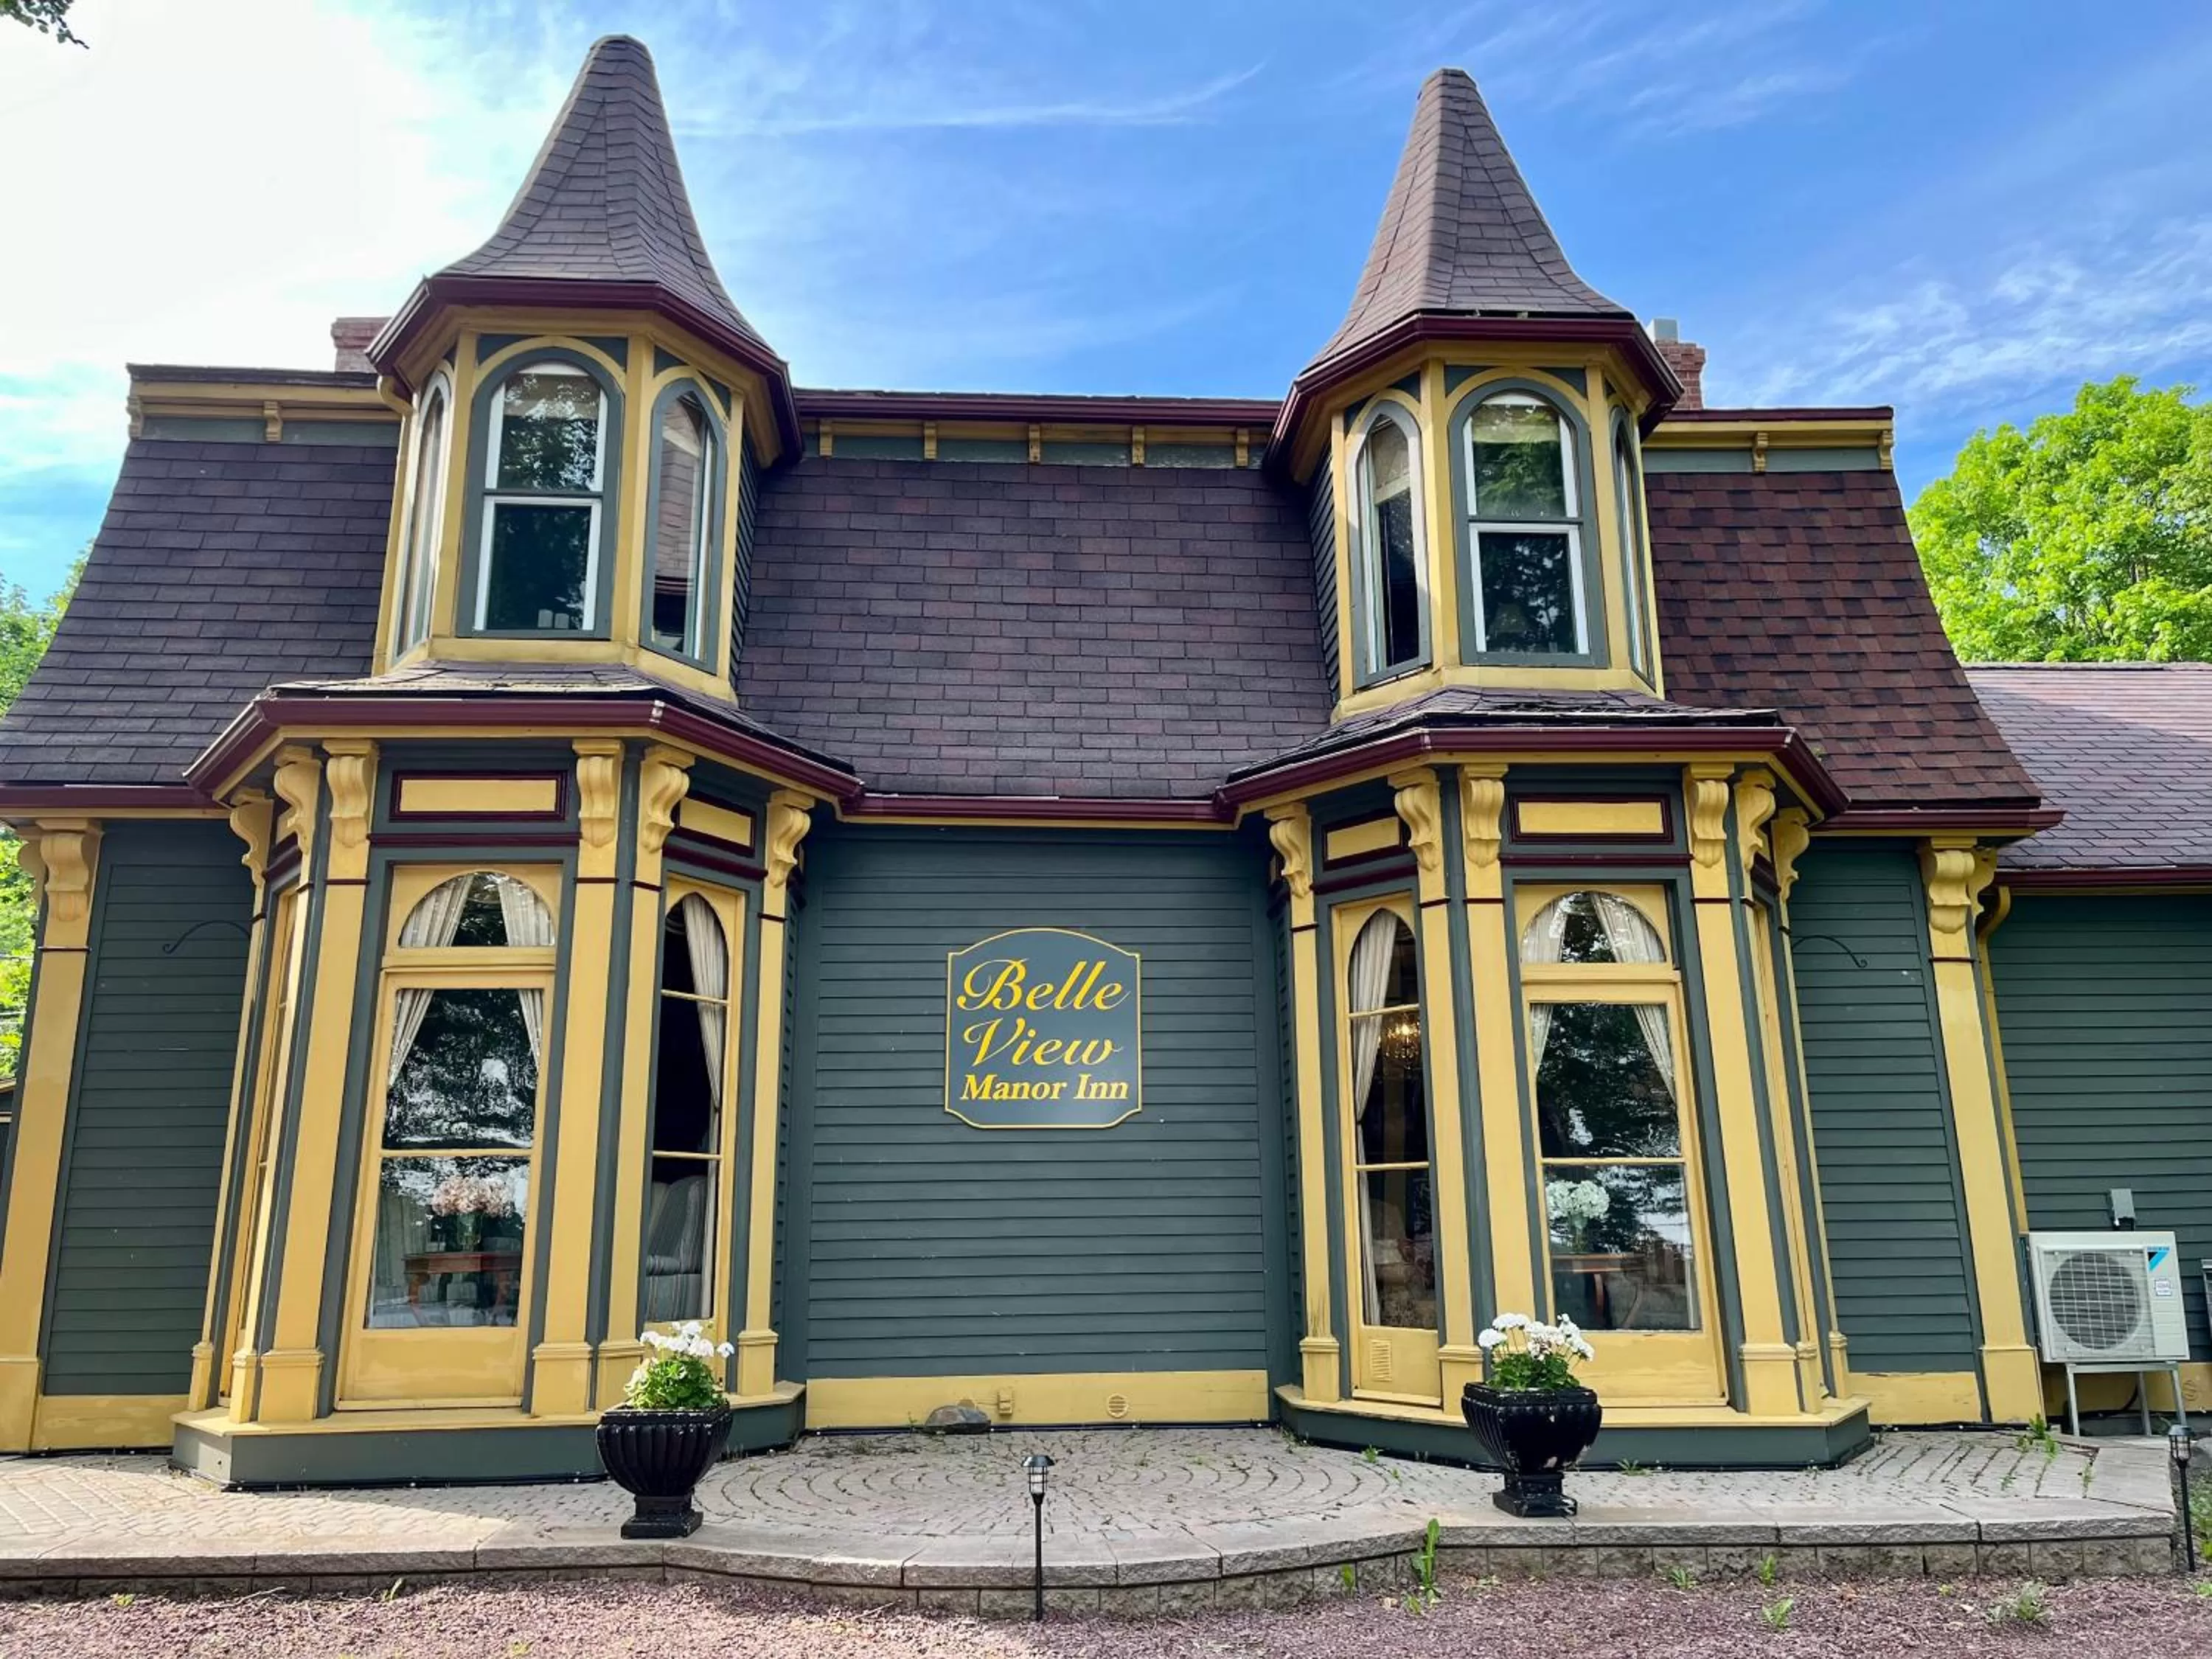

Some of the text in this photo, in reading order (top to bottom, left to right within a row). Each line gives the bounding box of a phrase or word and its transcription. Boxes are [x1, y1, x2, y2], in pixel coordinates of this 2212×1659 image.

[956, 958, 1131, 1011] Belle
[963, 1017, 1124, 1067] View
[959, 1073, 1129, 1101] Manor Inn
